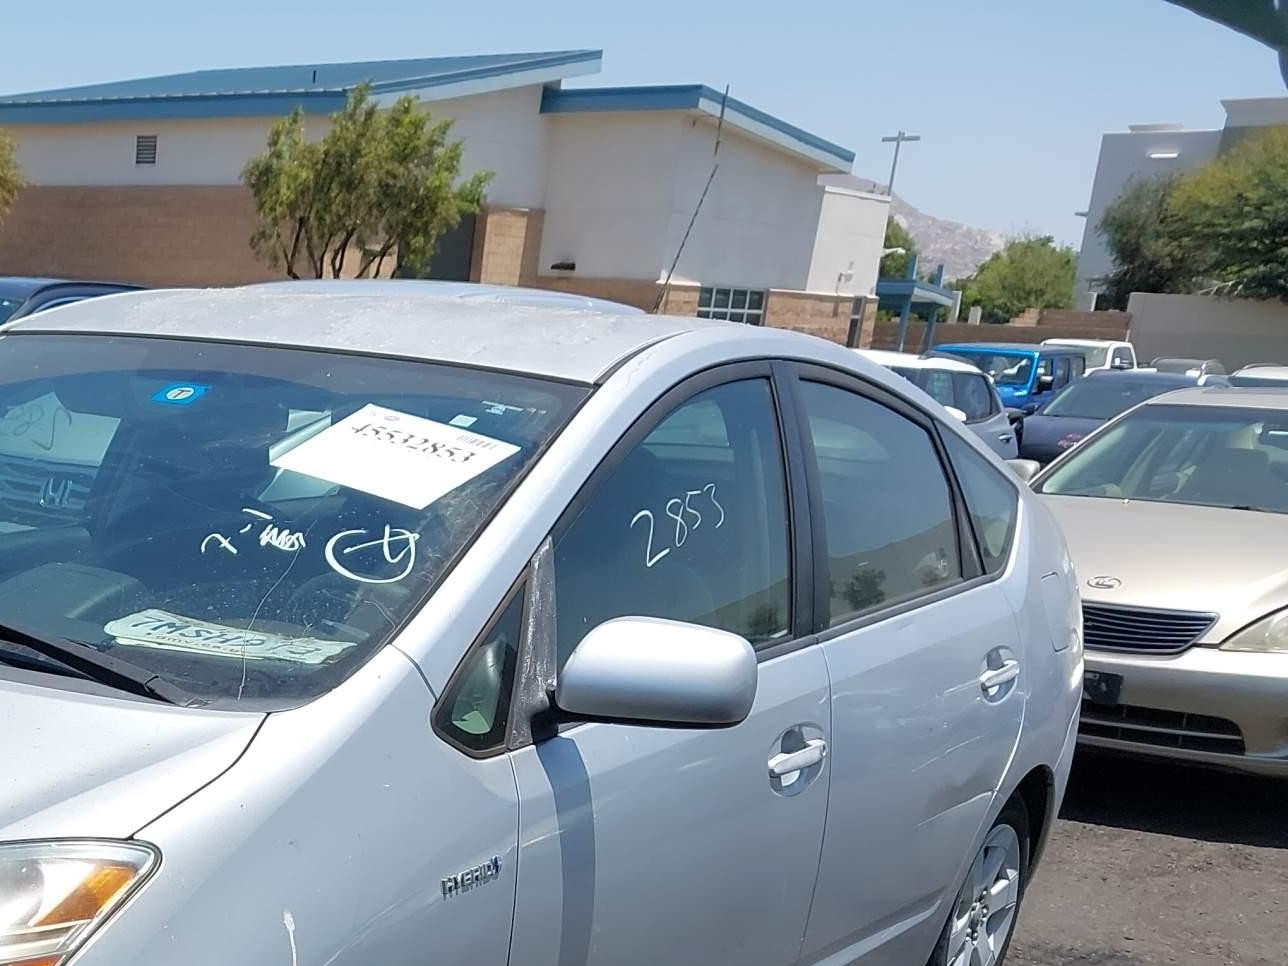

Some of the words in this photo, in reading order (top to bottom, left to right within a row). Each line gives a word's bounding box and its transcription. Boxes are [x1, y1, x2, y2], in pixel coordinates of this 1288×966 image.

[351, 422, 477, 463] 45532853
[630, 483, 724, 567] 2853
[440, 854, 502, 895] HYBRID
